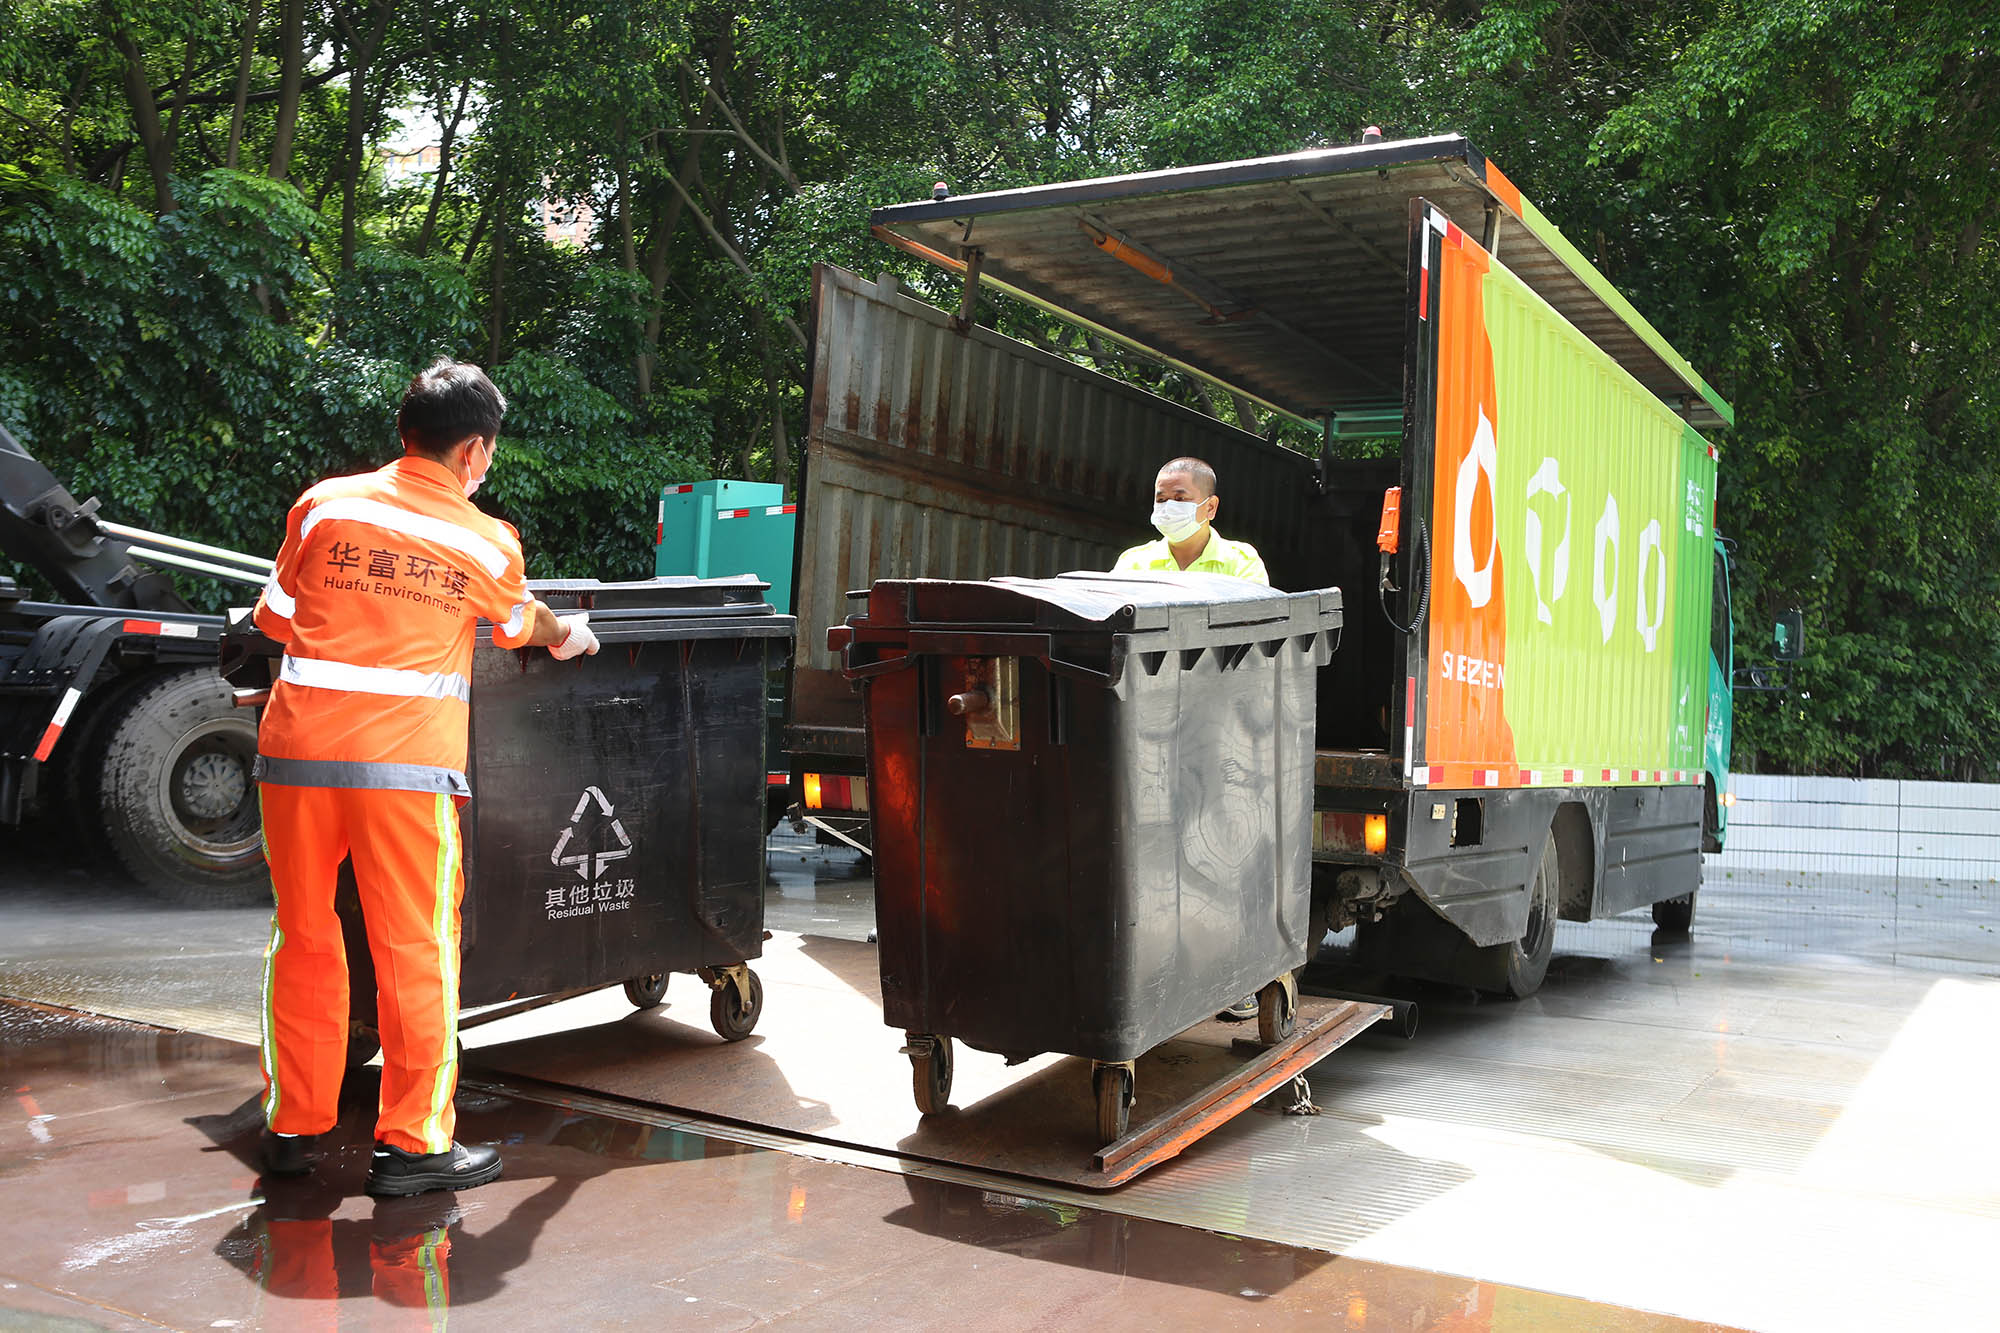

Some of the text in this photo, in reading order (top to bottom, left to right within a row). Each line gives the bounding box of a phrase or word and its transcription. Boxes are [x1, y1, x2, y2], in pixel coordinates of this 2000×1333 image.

[326, 540, 470, 601] 华富环境
[324, 576, 462, 618] Huafu Environment
[544, 878, 635, 910] 其他垃圾
[547, 899, 631, 921] Residual Waste
